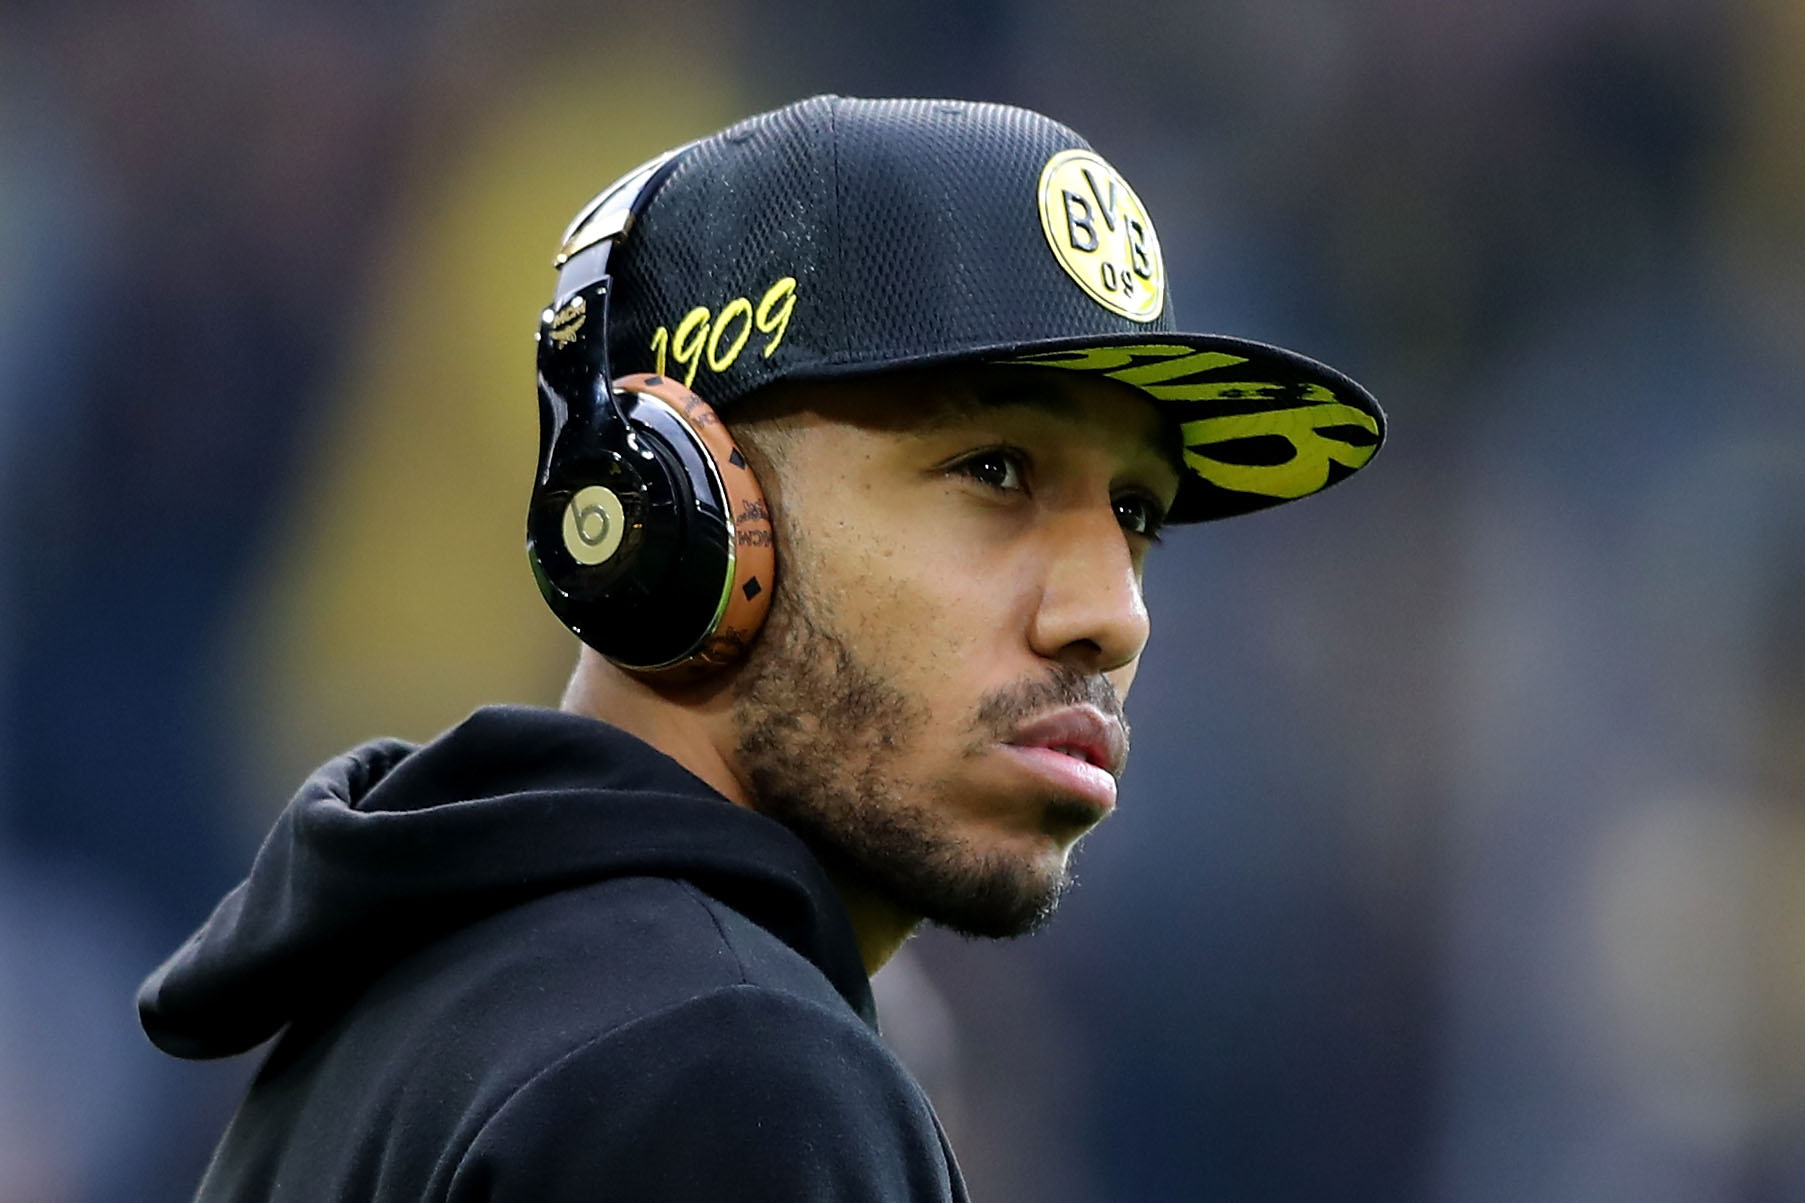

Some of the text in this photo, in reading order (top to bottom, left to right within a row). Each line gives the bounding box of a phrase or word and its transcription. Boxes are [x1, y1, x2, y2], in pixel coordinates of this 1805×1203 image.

[1062, 168, 1152, 280] BVB
[650, 277, 797, 389] 1909
[1101, 262, 1134, 299] 09
